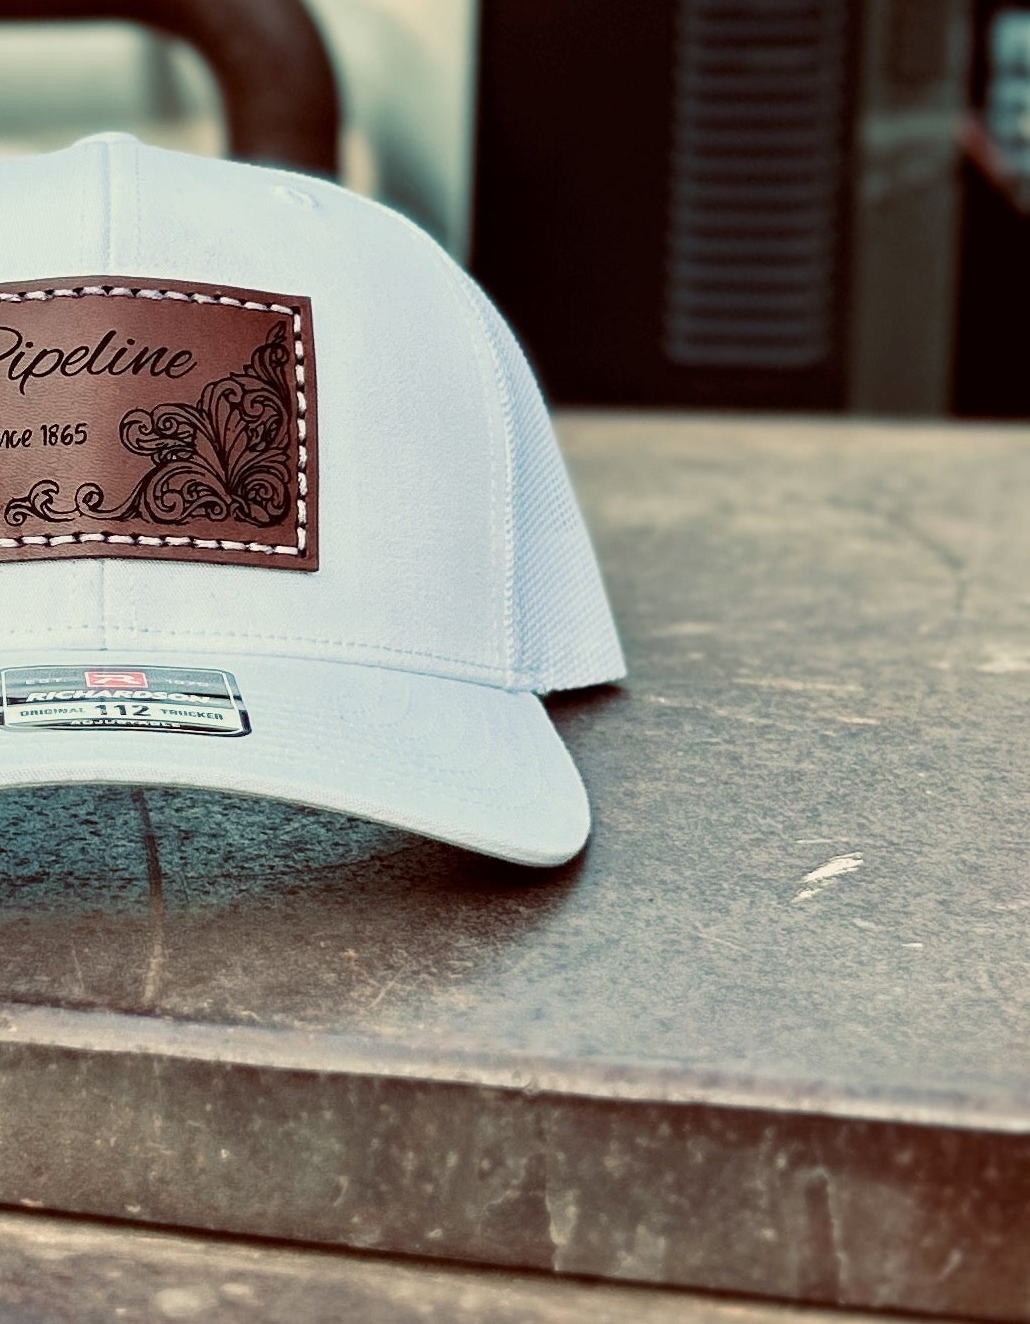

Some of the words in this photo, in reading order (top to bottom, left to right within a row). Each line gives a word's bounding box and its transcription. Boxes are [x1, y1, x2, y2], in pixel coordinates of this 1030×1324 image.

[41, 422, 88, 446] 1865
[25, 689, 210, 703] RICHARDSON
[20, 707, 84, 717] ORIGINAL
[94, 704, 151, 717] 112
[160, 708, 224, 720] TRUCKER
